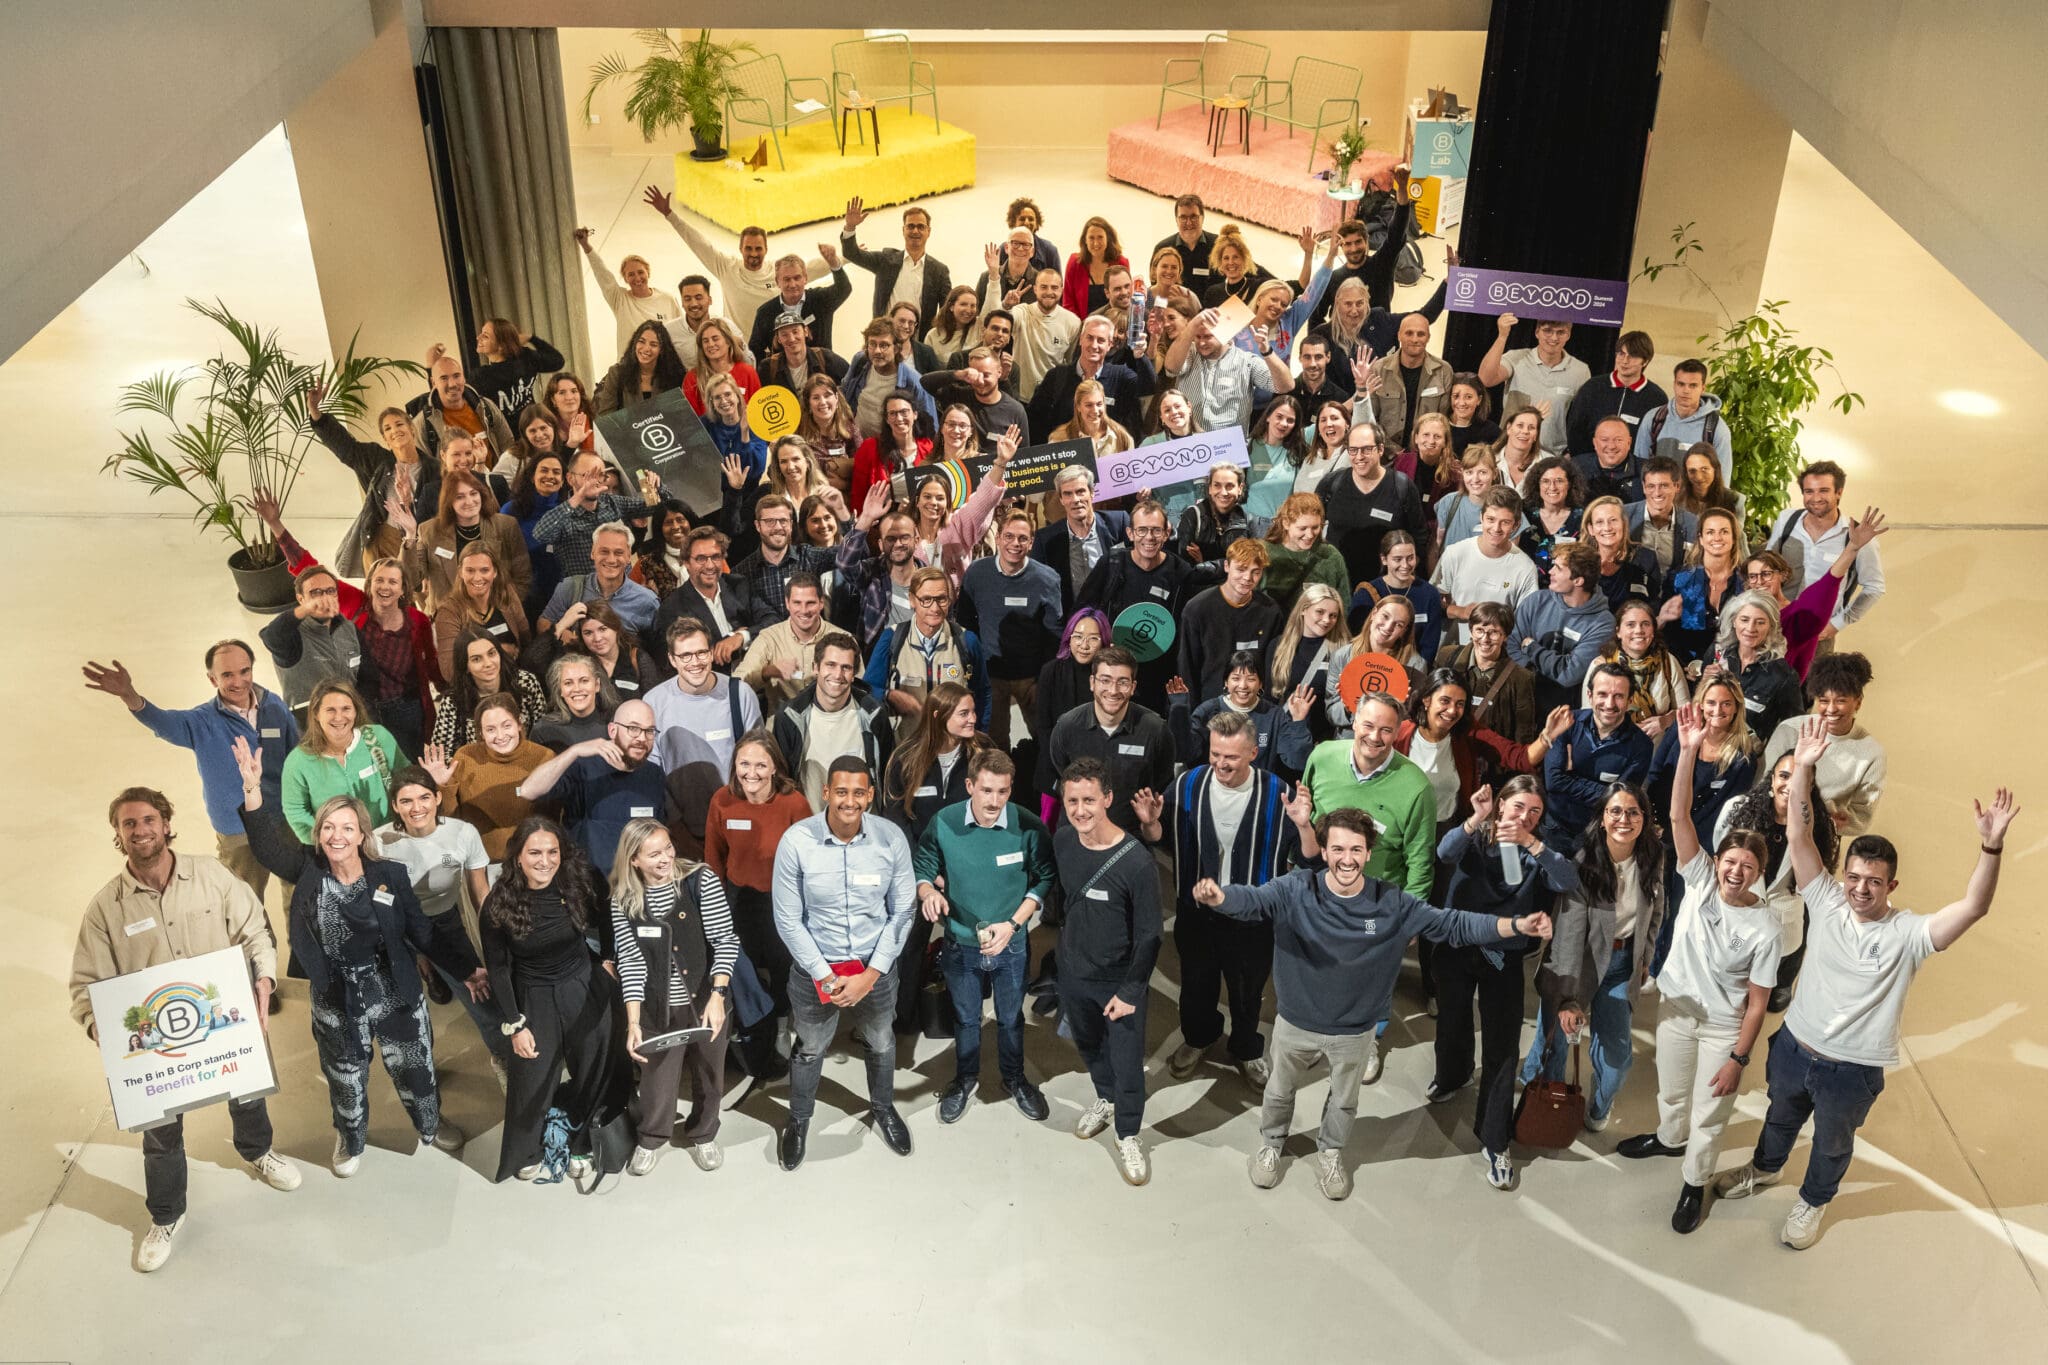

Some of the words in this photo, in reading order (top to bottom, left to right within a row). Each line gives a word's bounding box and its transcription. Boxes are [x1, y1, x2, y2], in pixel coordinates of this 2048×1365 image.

[1430, 155, 1451, 165] Lab
[1494, 286, 1586, 305] BEYOND
[632, 413, 664, 429] Certified
[1058, 450, 1077, 458] stop
[1012, 465, 1049, 477] business
[1115, 449, 1207, 478] BEYOND
[1020, 476, 1044, 488] good.
[1143, 610, 1166, 625] Certified
[1365, 661, 1393, 673] Certified
[123, 1077, 143, 1087] The
[145, 1072, 153, 1082] B
[155, 1070, 165, 1079] in
[167, 1066, 175, 1075] B
[177, 1061, 202, 1073] Corp
[204, 1050, 237, 1065] stands
[239, 1046, 253, 1055] for
[145, 1074, 195, 1096] Benefit
[197, 1069, 217, 1081] for
[221, 1061, 238, 1076] All
